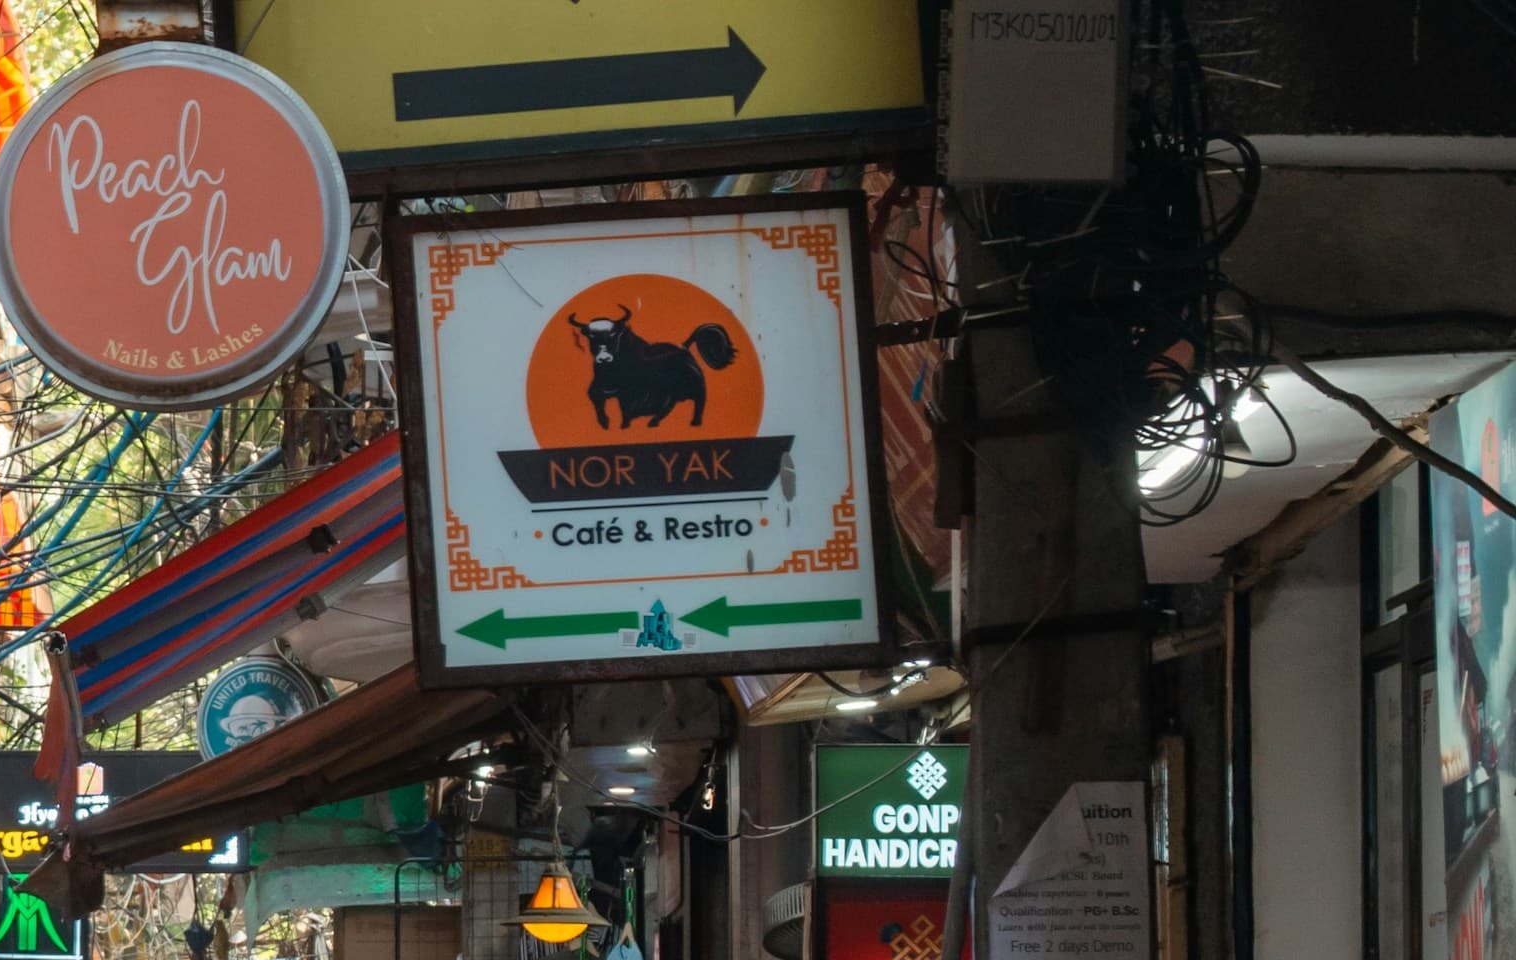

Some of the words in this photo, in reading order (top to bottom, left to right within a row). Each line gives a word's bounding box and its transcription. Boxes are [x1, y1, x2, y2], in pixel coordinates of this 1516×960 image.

[48, 99, 225, 234] Peach
[130, 189, 292, 336] Glam
[103, 338, 159, 370] Nails
[166, 350, 187, 370] &
[190, 321, 265, 368] Lashes
[549, 455, 635, 490] NOR
[657, 450, 734, 482] YAK
[551, 514, 624, 547] Café
[635, 520, 654, 543] &
[664, 514, 753, 541] Restro
[211, 674, 248, 711] UNITED
[249, 671, 292, 693] TRAVEL
[872, 803, 961, 834] GONP
[1081, 804, 1132, 819] uition
[821, 838, 959, 869] HANDICR
[1011, 940, 1041, 953] Free
[1045, 940, 1054, 953] 2
[1058, 940, 1089, 955] days
[1093, 940, 1134, 953] Demo
